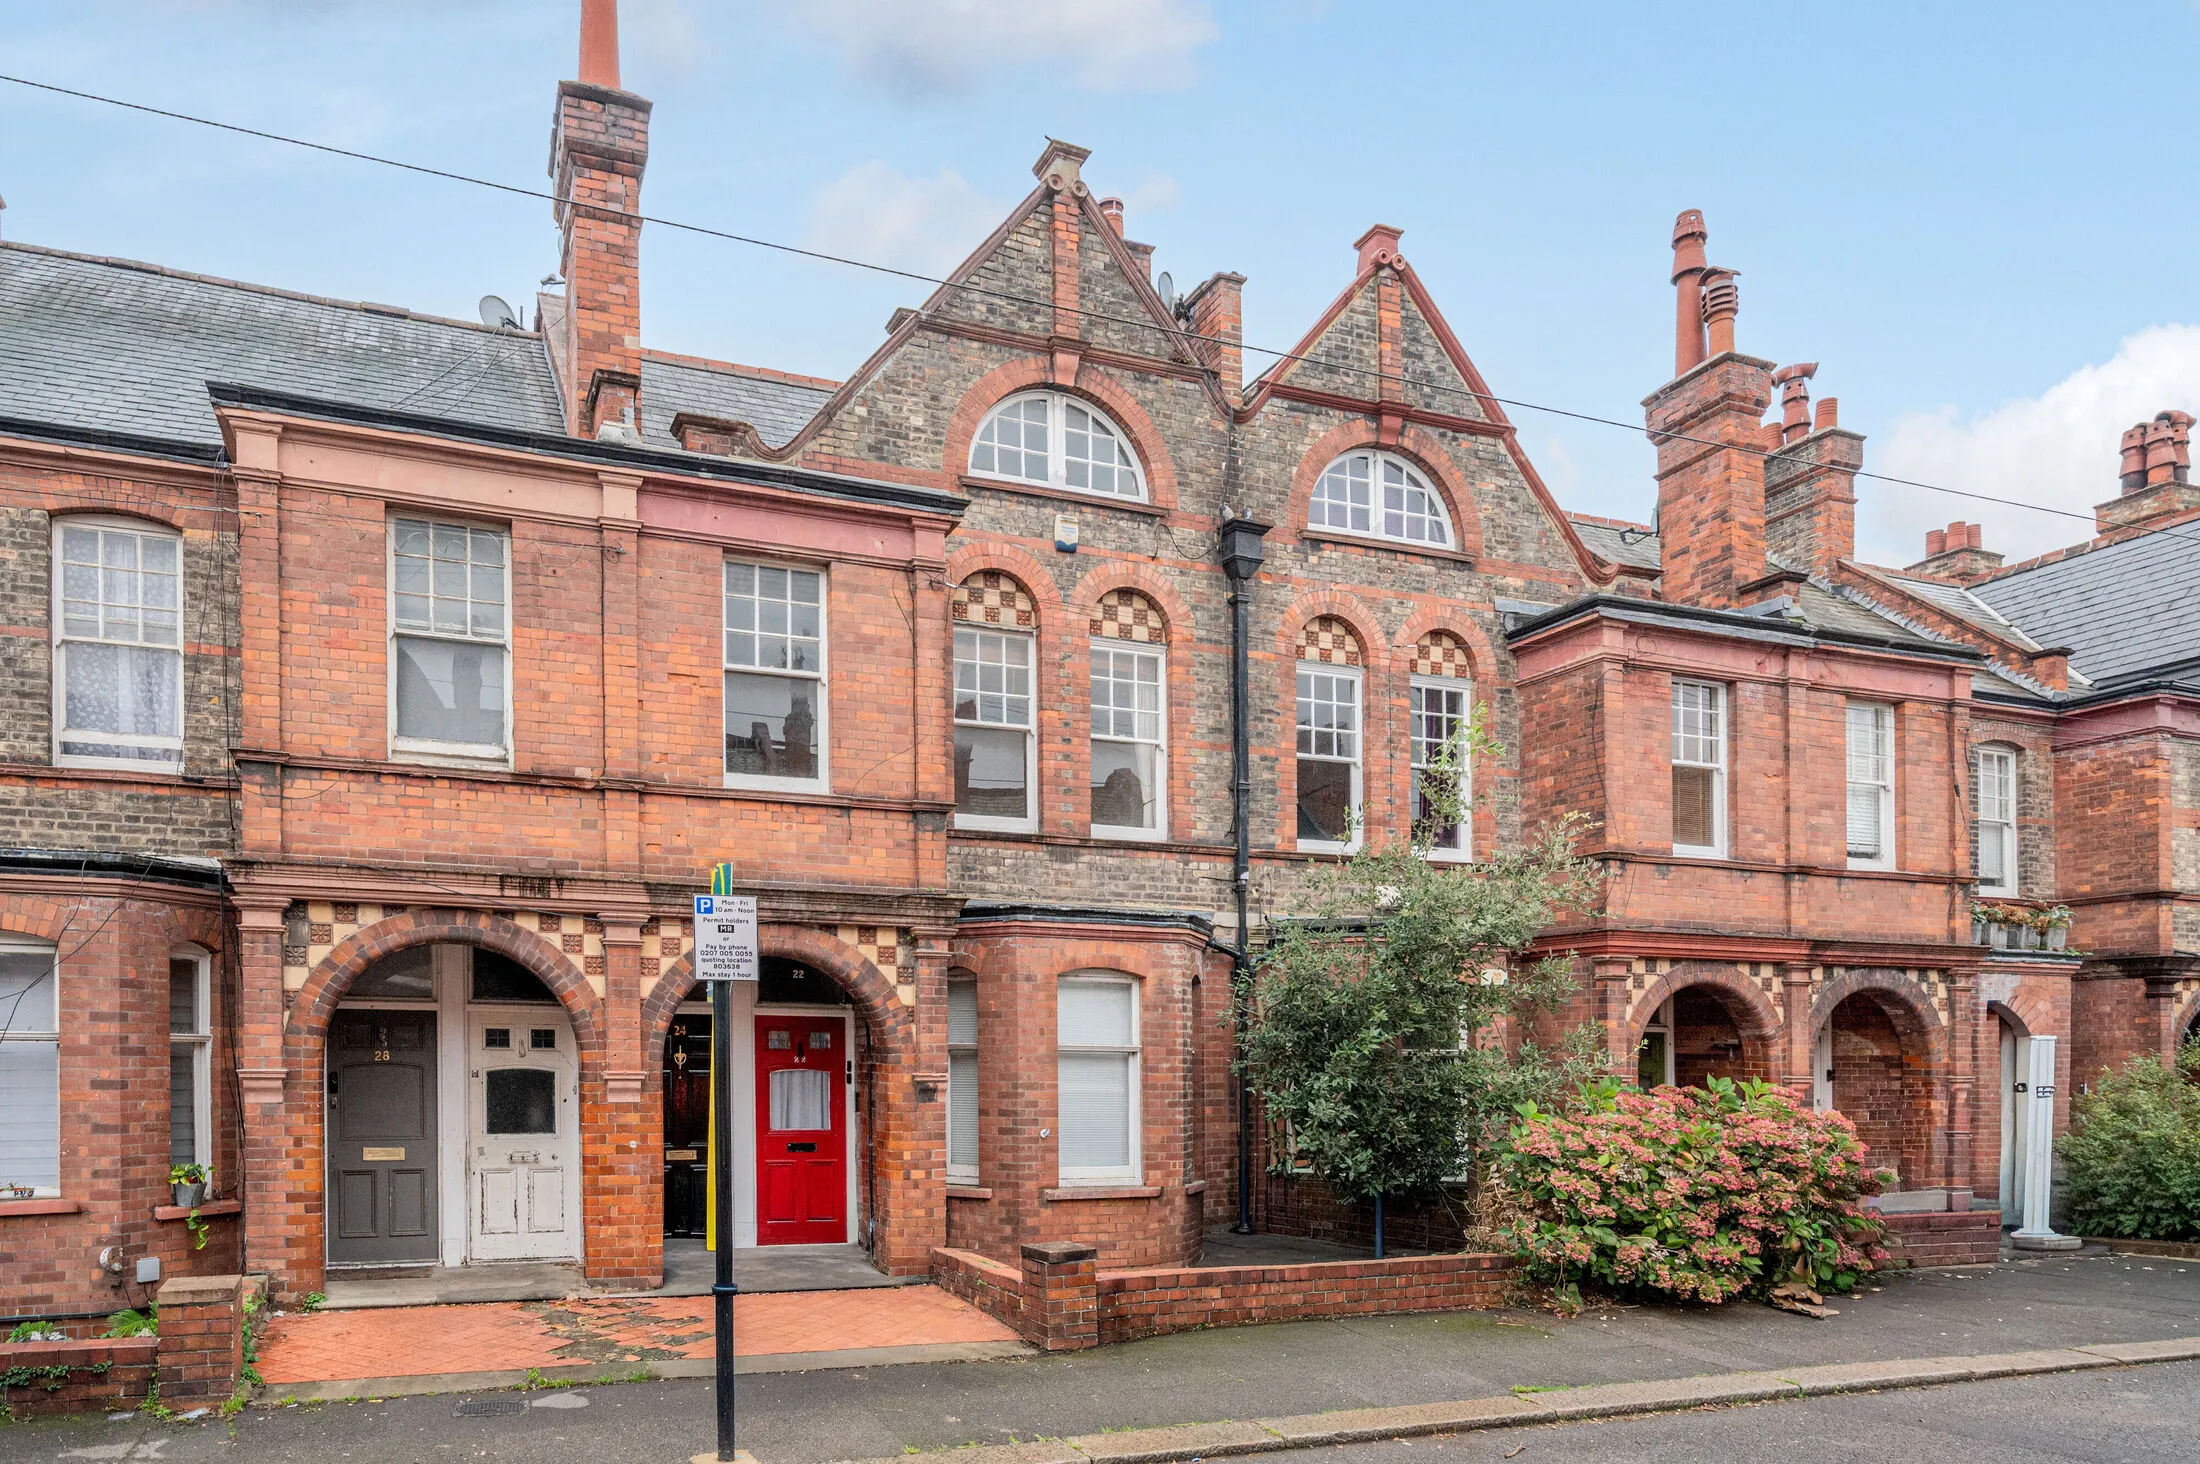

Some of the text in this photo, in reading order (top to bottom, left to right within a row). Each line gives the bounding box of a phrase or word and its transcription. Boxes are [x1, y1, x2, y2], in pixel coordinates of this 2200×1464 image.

[700, 899, 711, 913] P
[792, 969, 804, 979] 22
[673, 1025, 686, 1036] 24
[793, 1055, 807, 1063] 22
